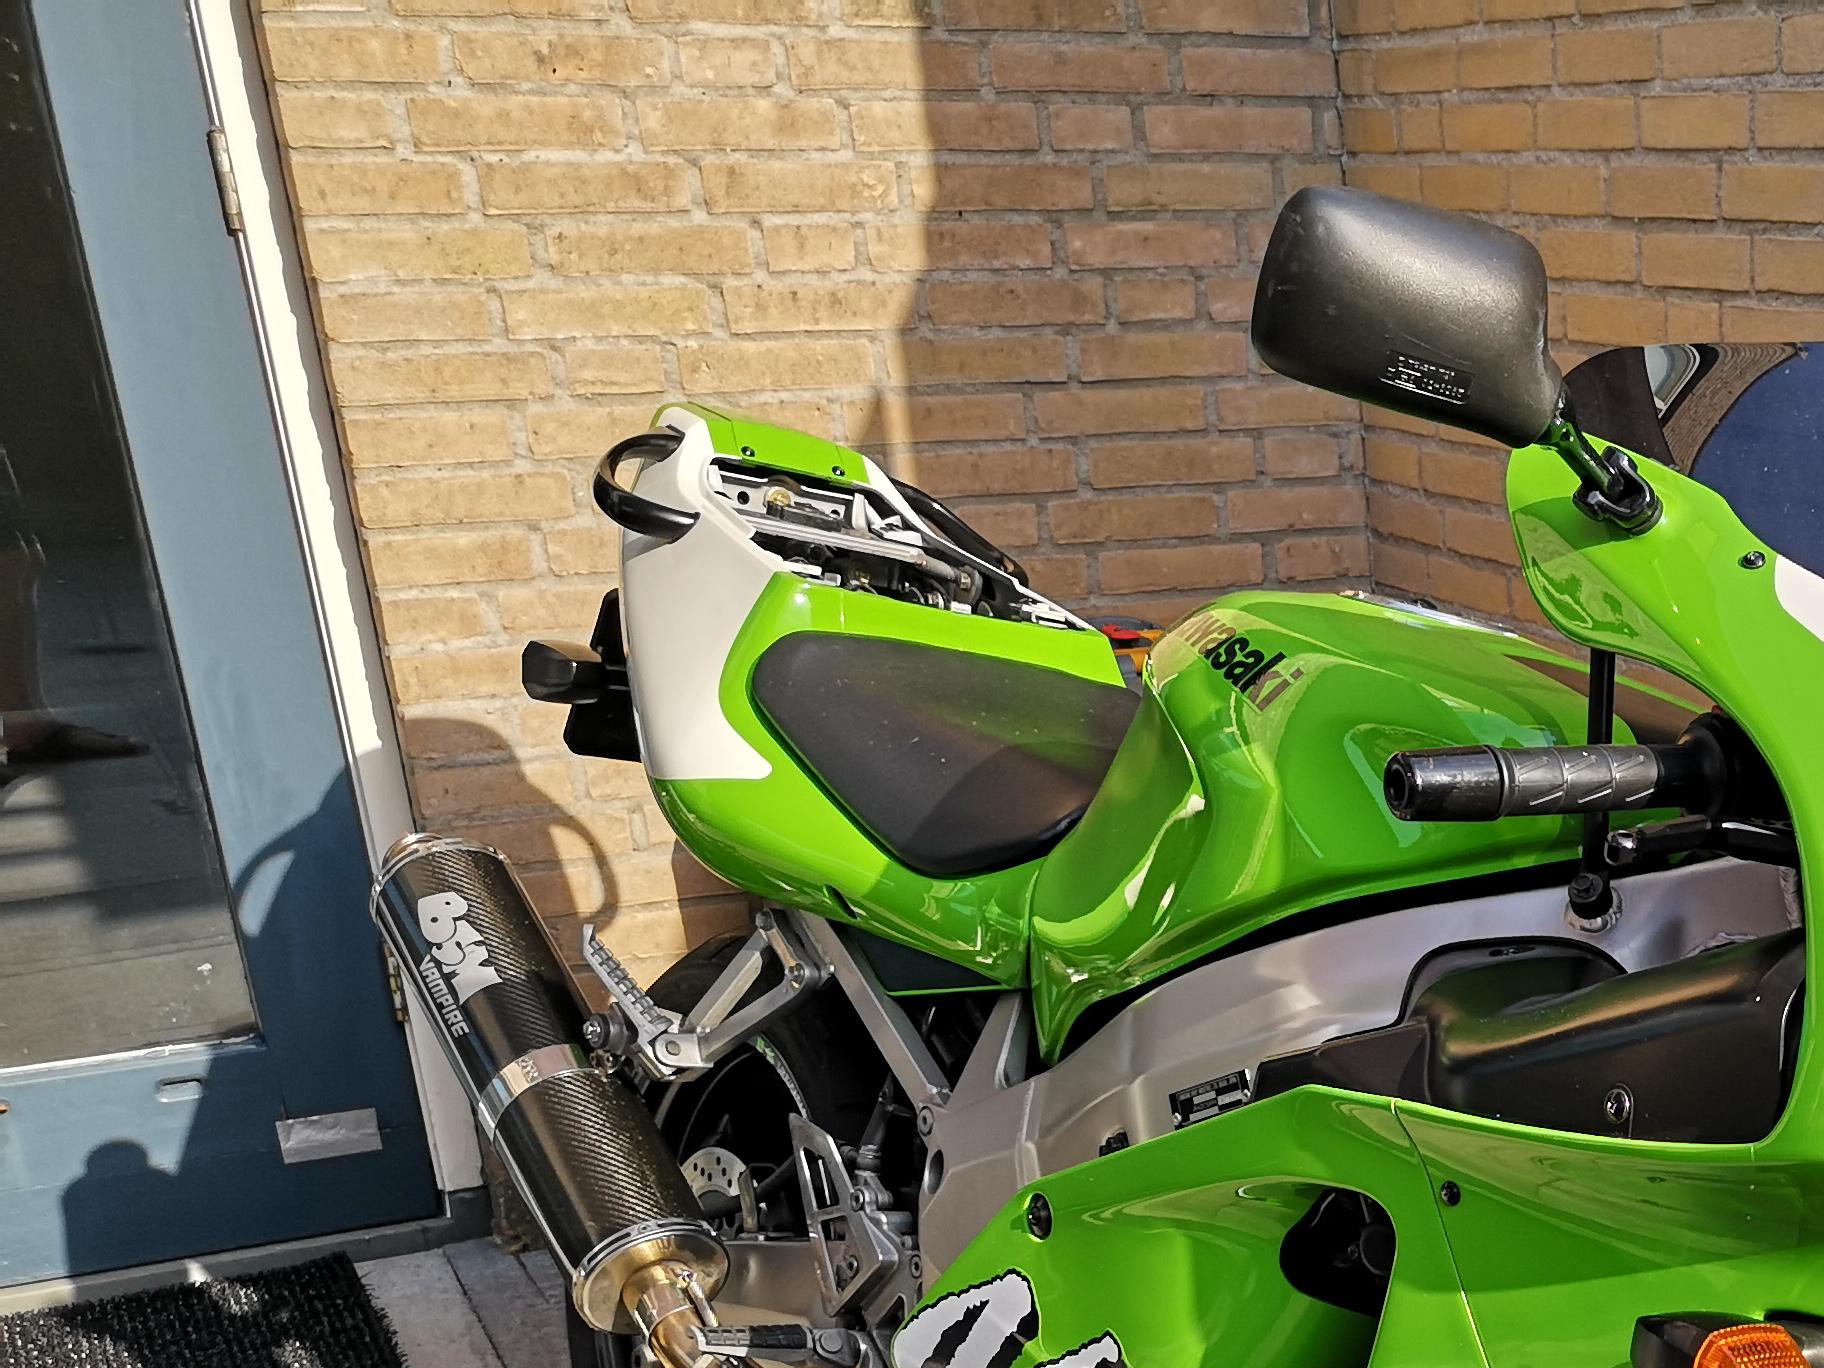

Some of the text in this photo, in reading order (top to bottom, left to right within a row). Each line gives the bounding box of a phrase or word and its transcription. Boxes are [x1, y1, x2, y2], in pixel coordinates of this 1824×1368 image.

[1180, 611, 1305, 712] wasaki
[417, 891, 503, 1006] BSM
[419, 954, 471, 1038] VAMPIRE
